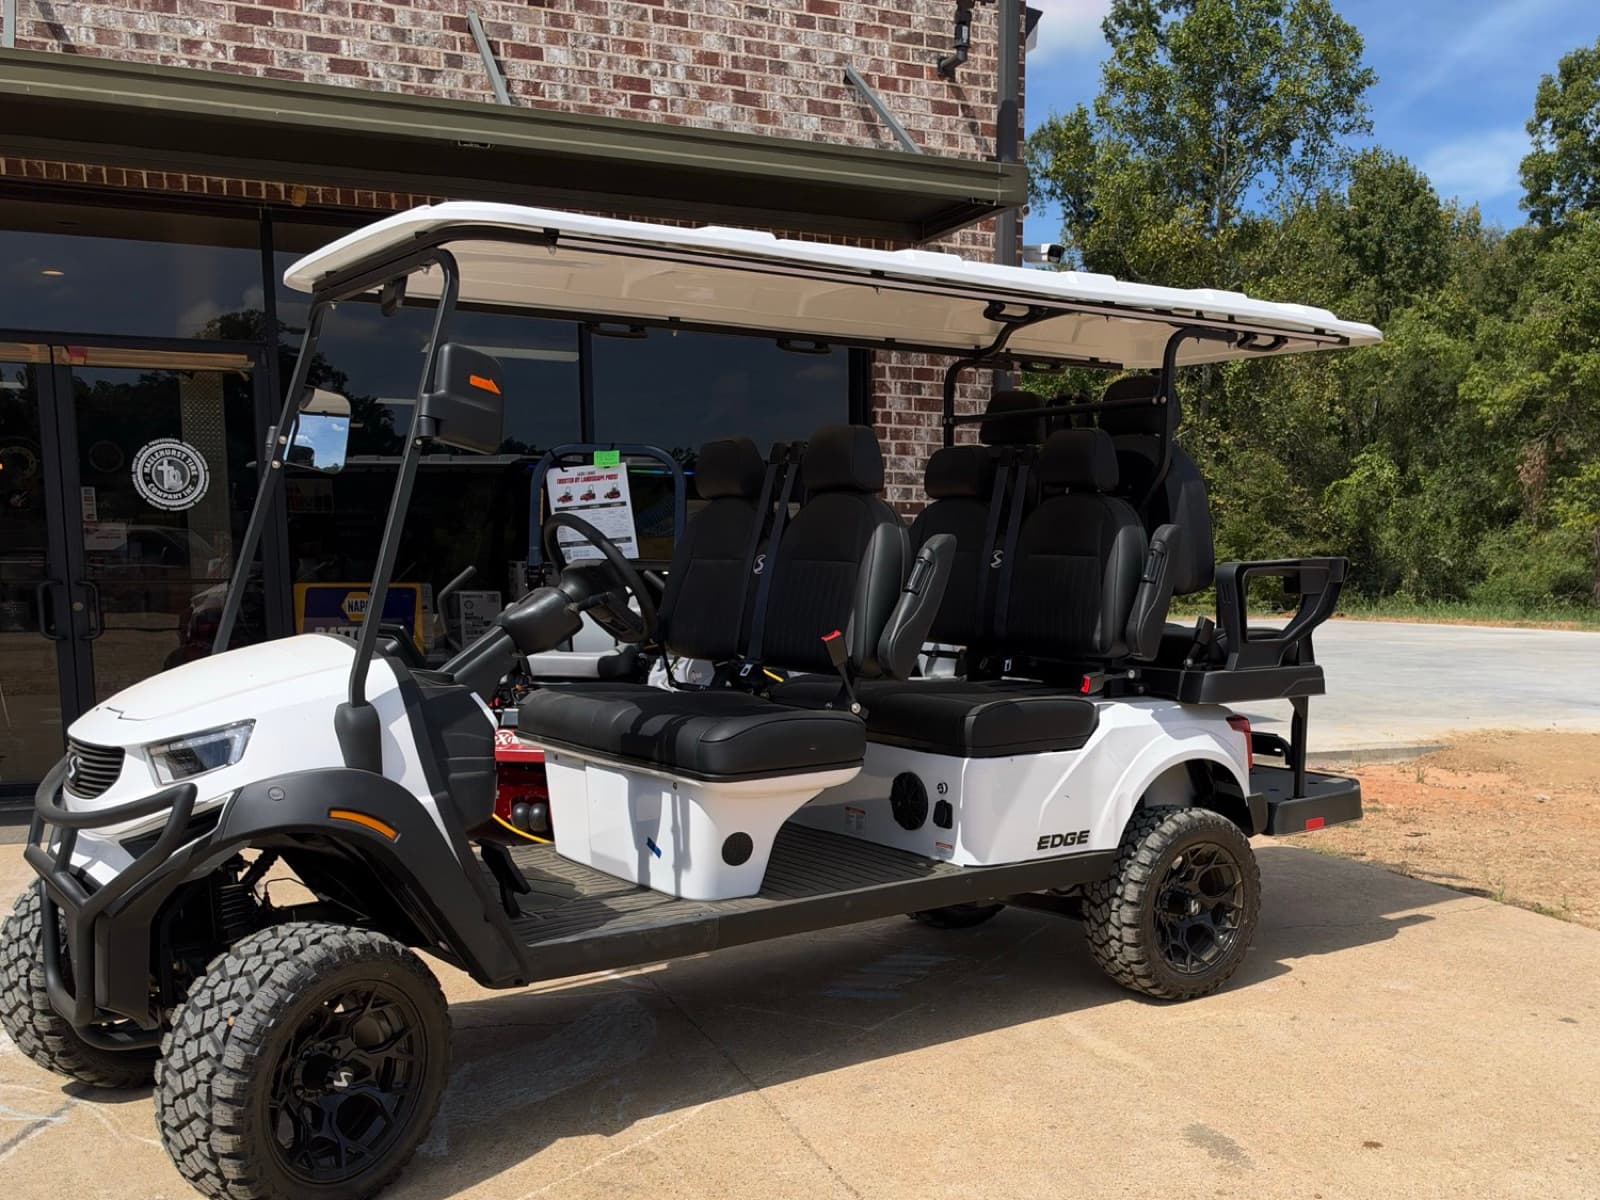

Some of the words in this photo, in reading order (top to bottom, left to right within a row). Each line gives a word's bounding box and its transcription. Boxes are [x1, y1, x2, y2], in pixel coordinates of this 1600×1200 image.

[186, 457, 198, 476] TIRE
[148, 483, 183, 499] COMPANY
[182, 485, 195, 497] INC
[348, 599, 369, 613] NAP
[1037, 830, 1090, 850] EDGE
